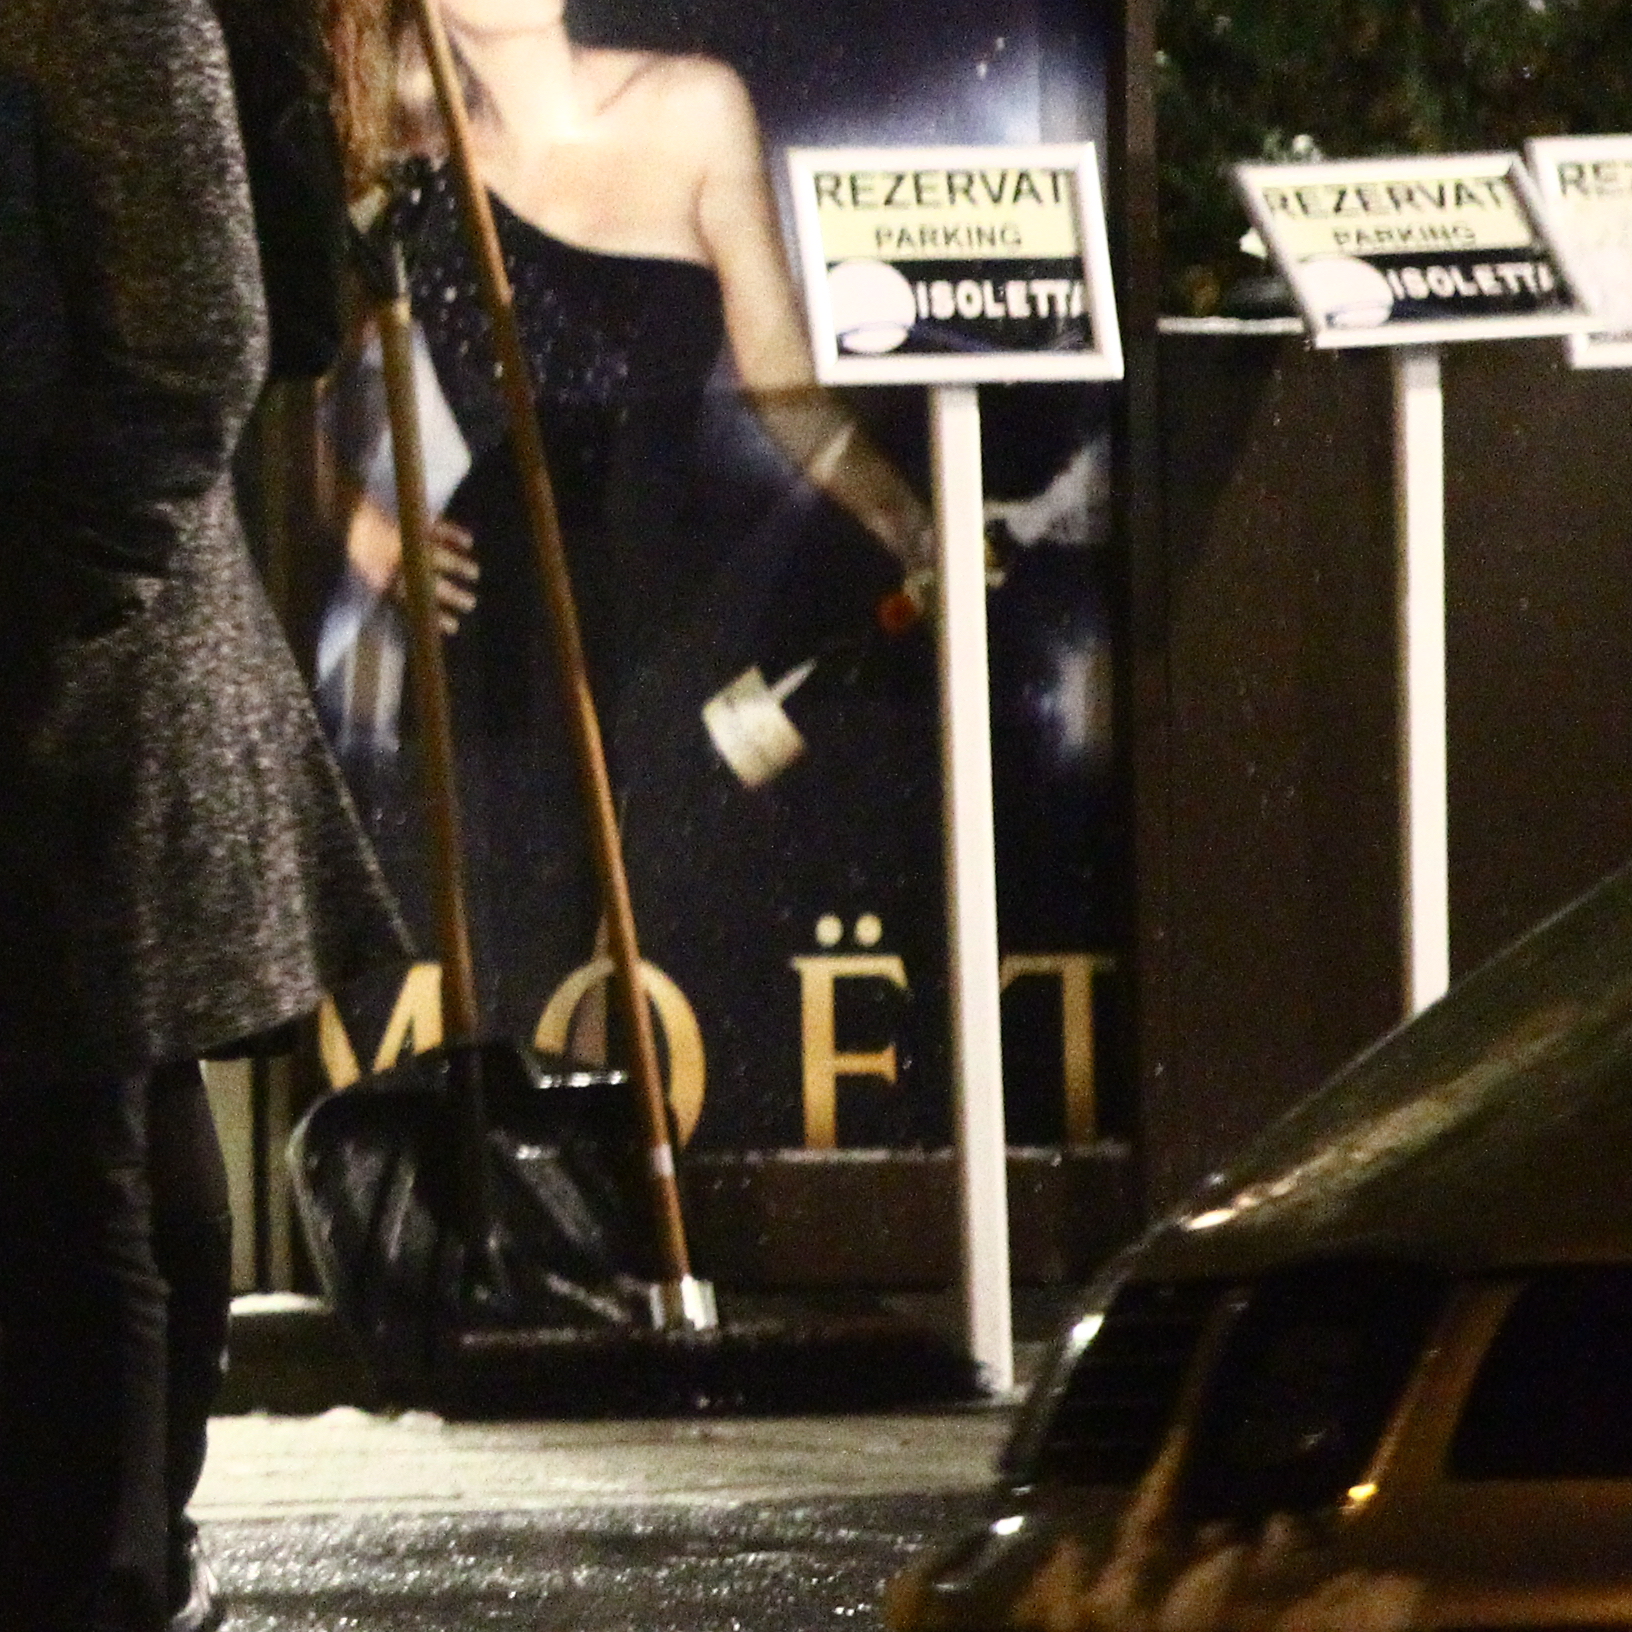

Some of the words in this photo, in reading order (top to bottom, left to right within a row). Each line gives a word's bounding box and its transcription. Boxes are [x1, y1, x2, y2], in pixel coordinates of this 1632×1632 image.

[814, 169, 1072, 208] REZERVAT
[1263, 178, 1513, 219] REZERVAT
[874, 224, 1023, 250] PARKING
[1334, 221, 1477, 245] PARKING
